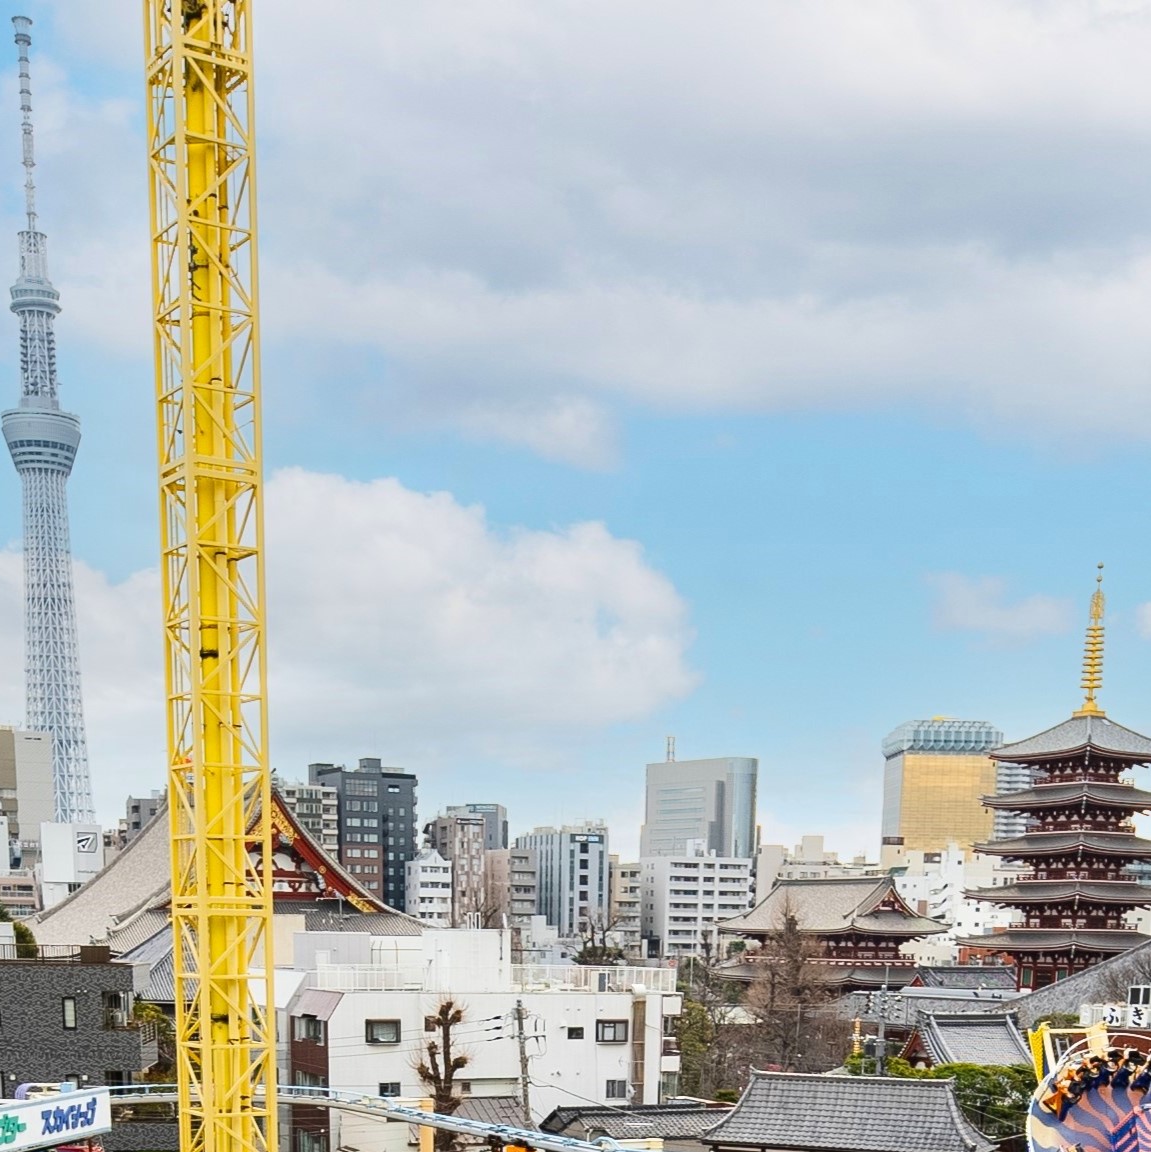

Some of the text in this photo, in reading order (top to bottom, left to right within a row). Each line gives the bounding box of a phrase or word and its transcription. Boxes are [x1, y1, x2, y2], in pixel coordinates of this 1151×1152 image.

[41, 1097, 97, 1135] スカイシップ
